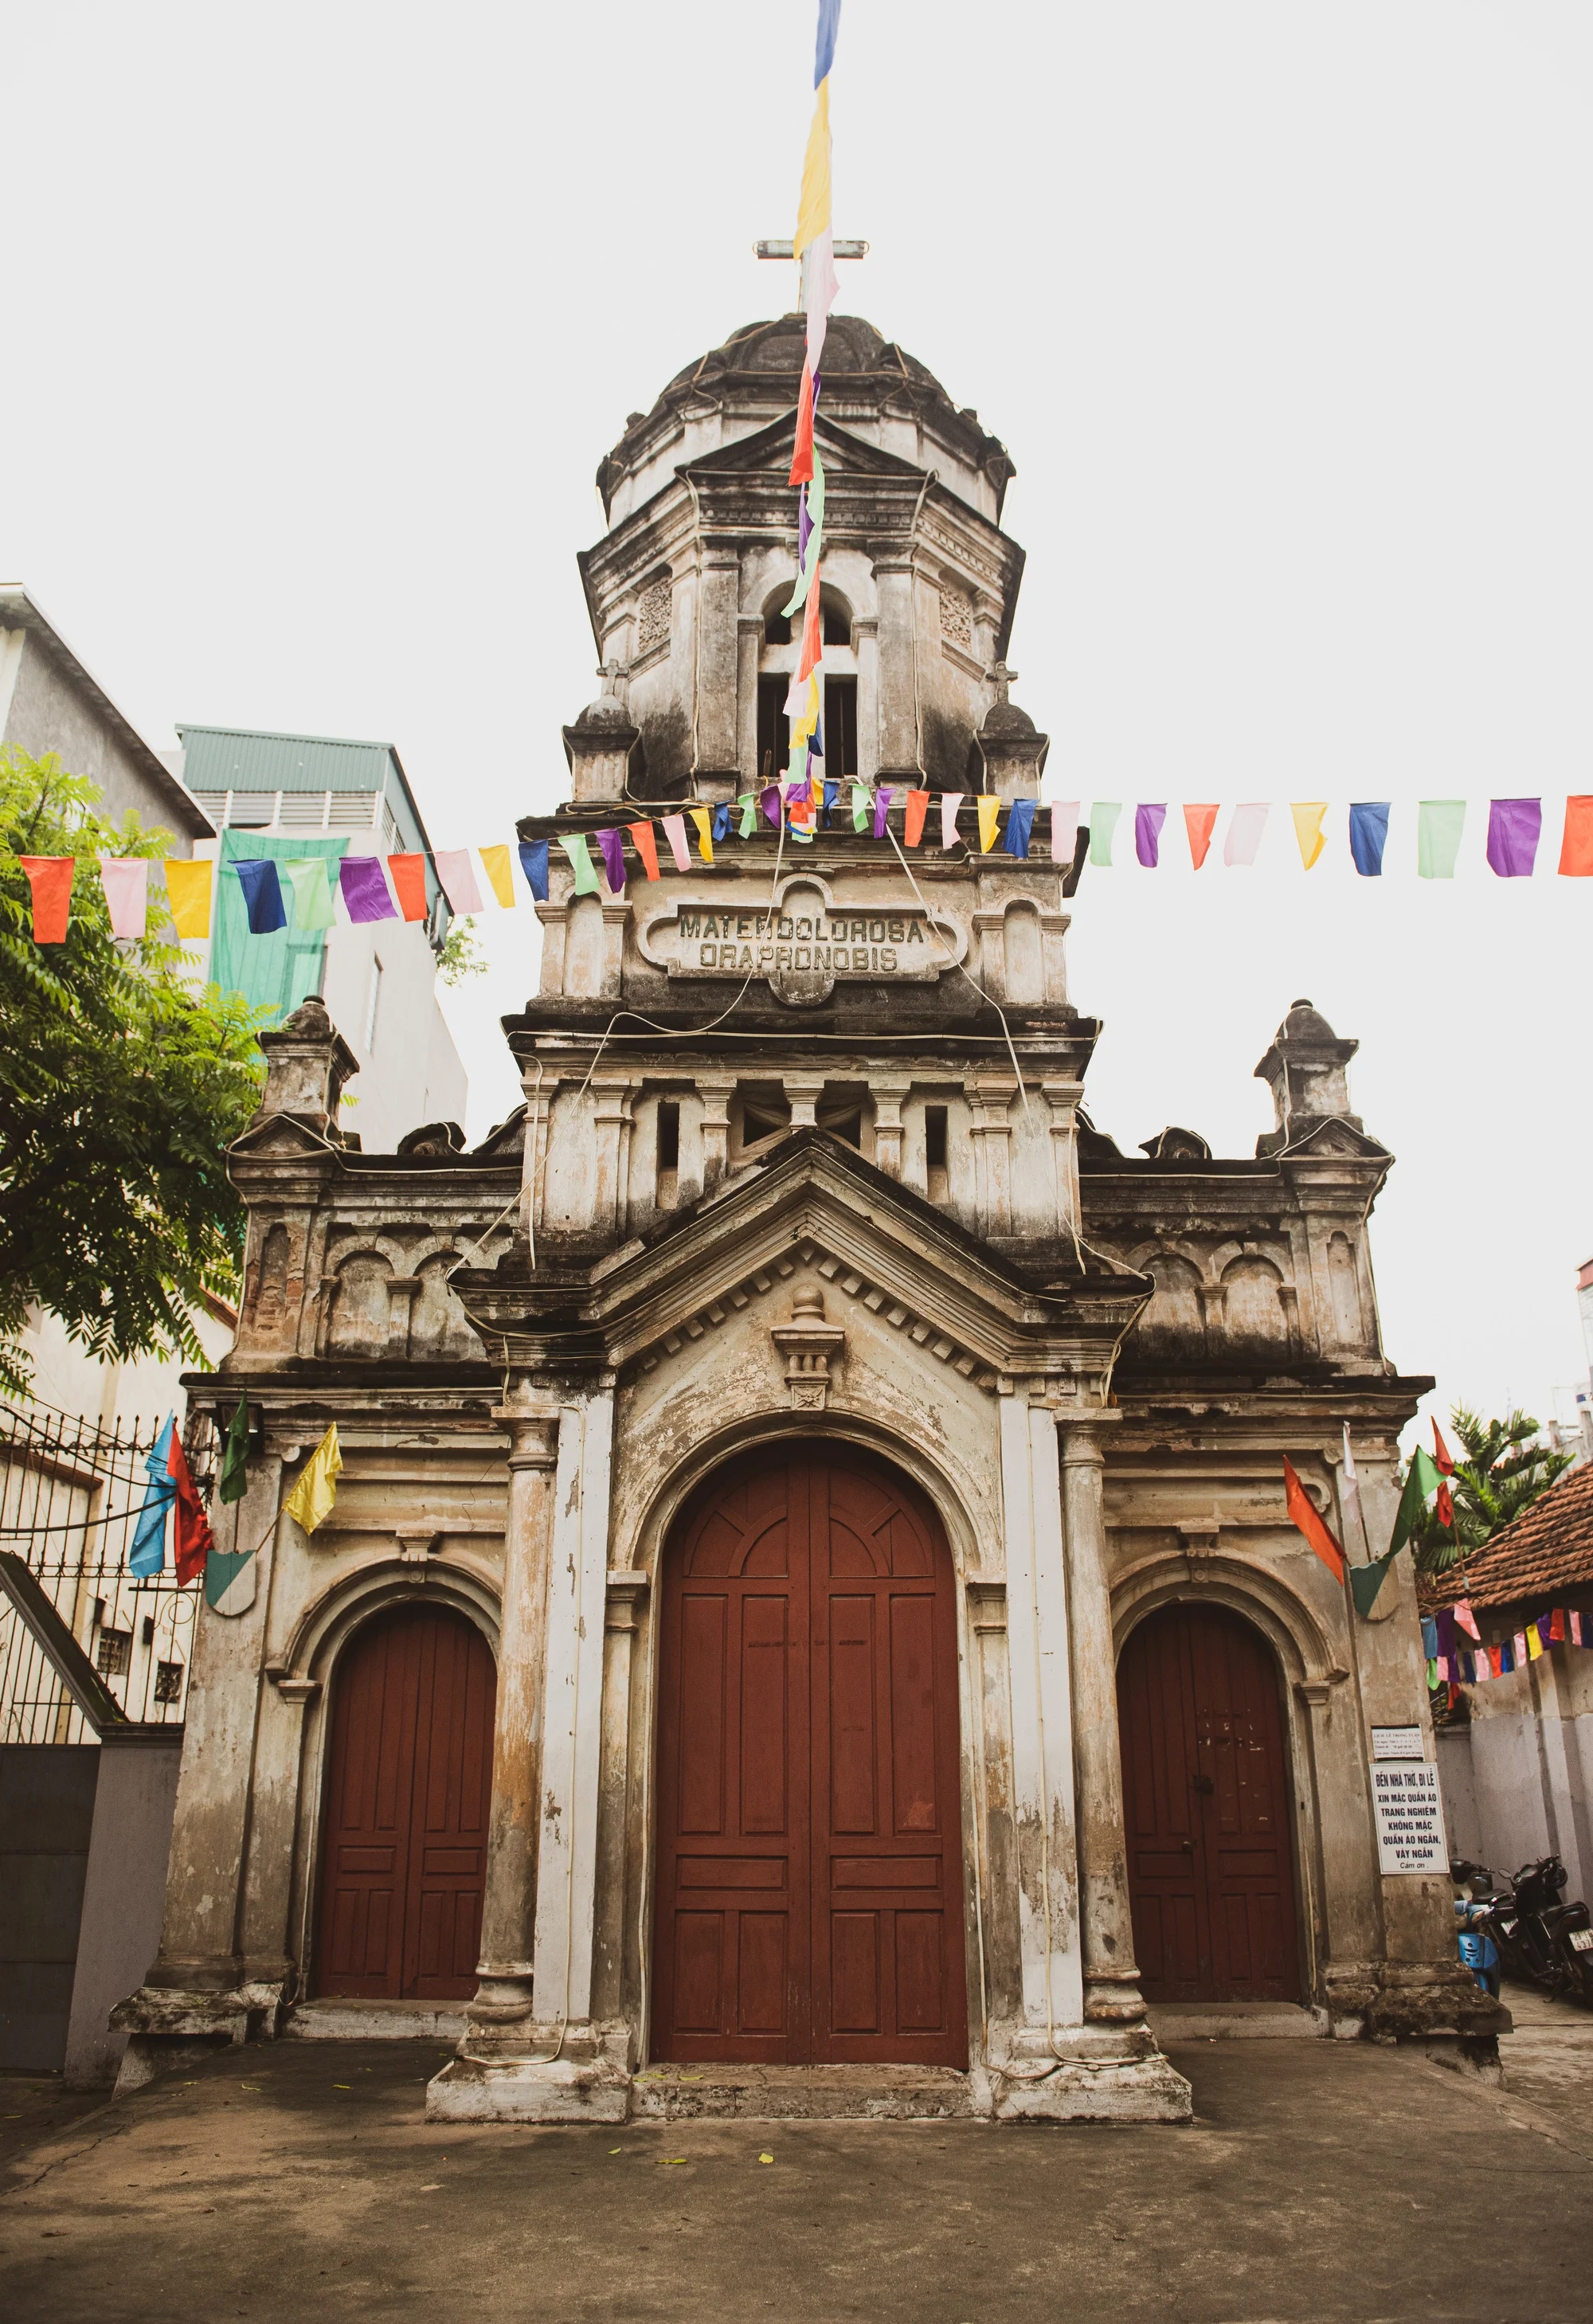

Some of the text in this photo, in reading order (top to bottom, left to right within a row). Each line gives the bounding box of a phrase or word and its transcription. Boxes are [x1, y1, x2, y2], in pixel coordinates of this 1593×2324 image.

[1419, 1773, 1426, 1786] ĐI
[1378, 1794, 1389, 1802] XIN
[1381, 1808, 1405, 1817] TRANG
